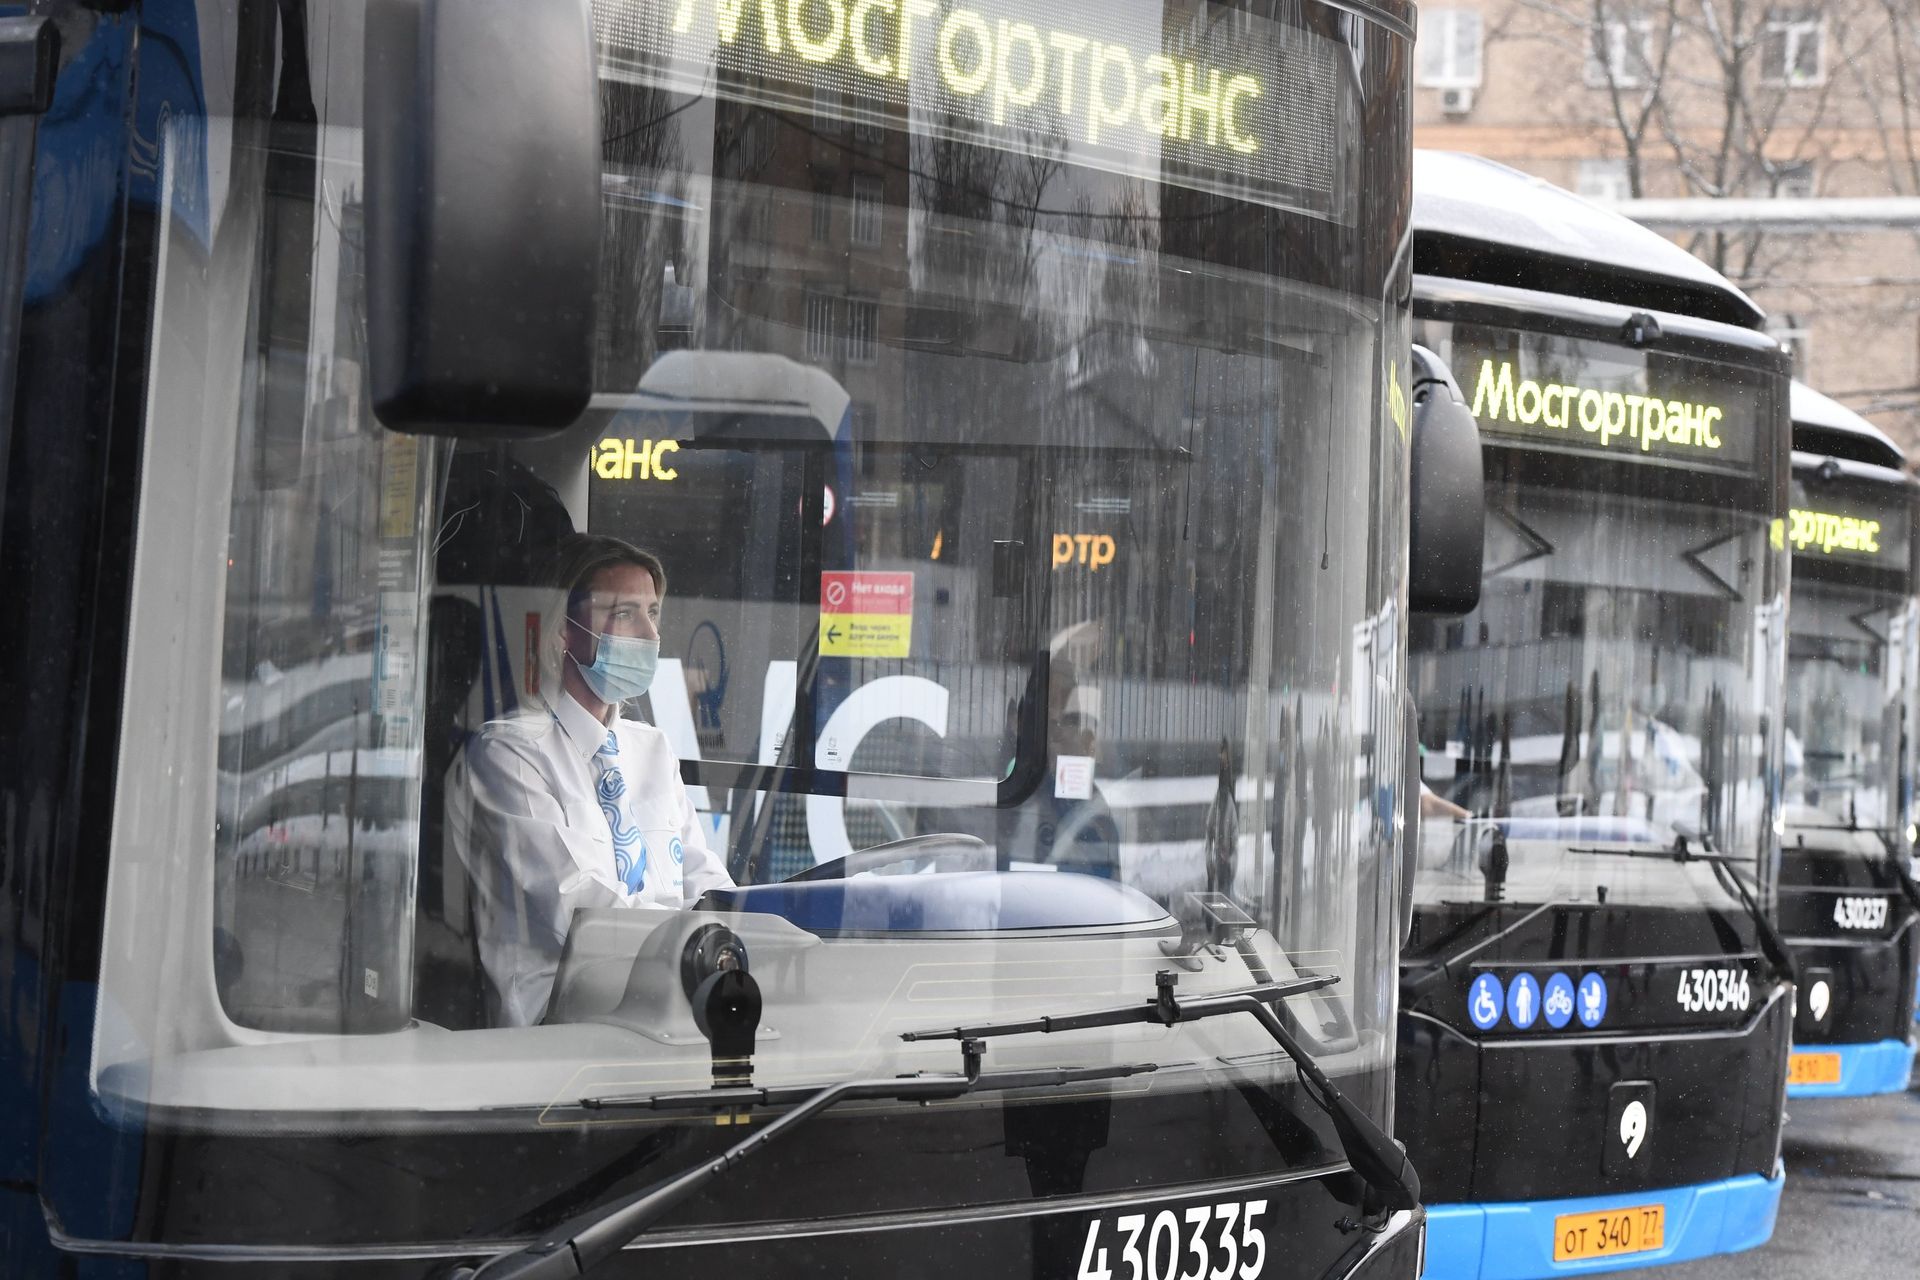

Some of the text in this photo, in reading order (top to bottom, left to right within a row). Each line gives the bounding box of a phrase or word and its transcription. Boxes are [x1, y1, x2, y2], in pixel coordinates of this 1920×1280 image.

[1472, 358, 1723, 451] Мосгортранс
[591, 438, 680, 480] анс
[1833, 896, 1888, 930] 430237
[1677, 968, 1750, 1012] 430346
[1077, 1199, 1268, 1280] 430335
[1597, 1215, 1631, 1250] 340
[1643, 1210, 1658, 1235] 77
